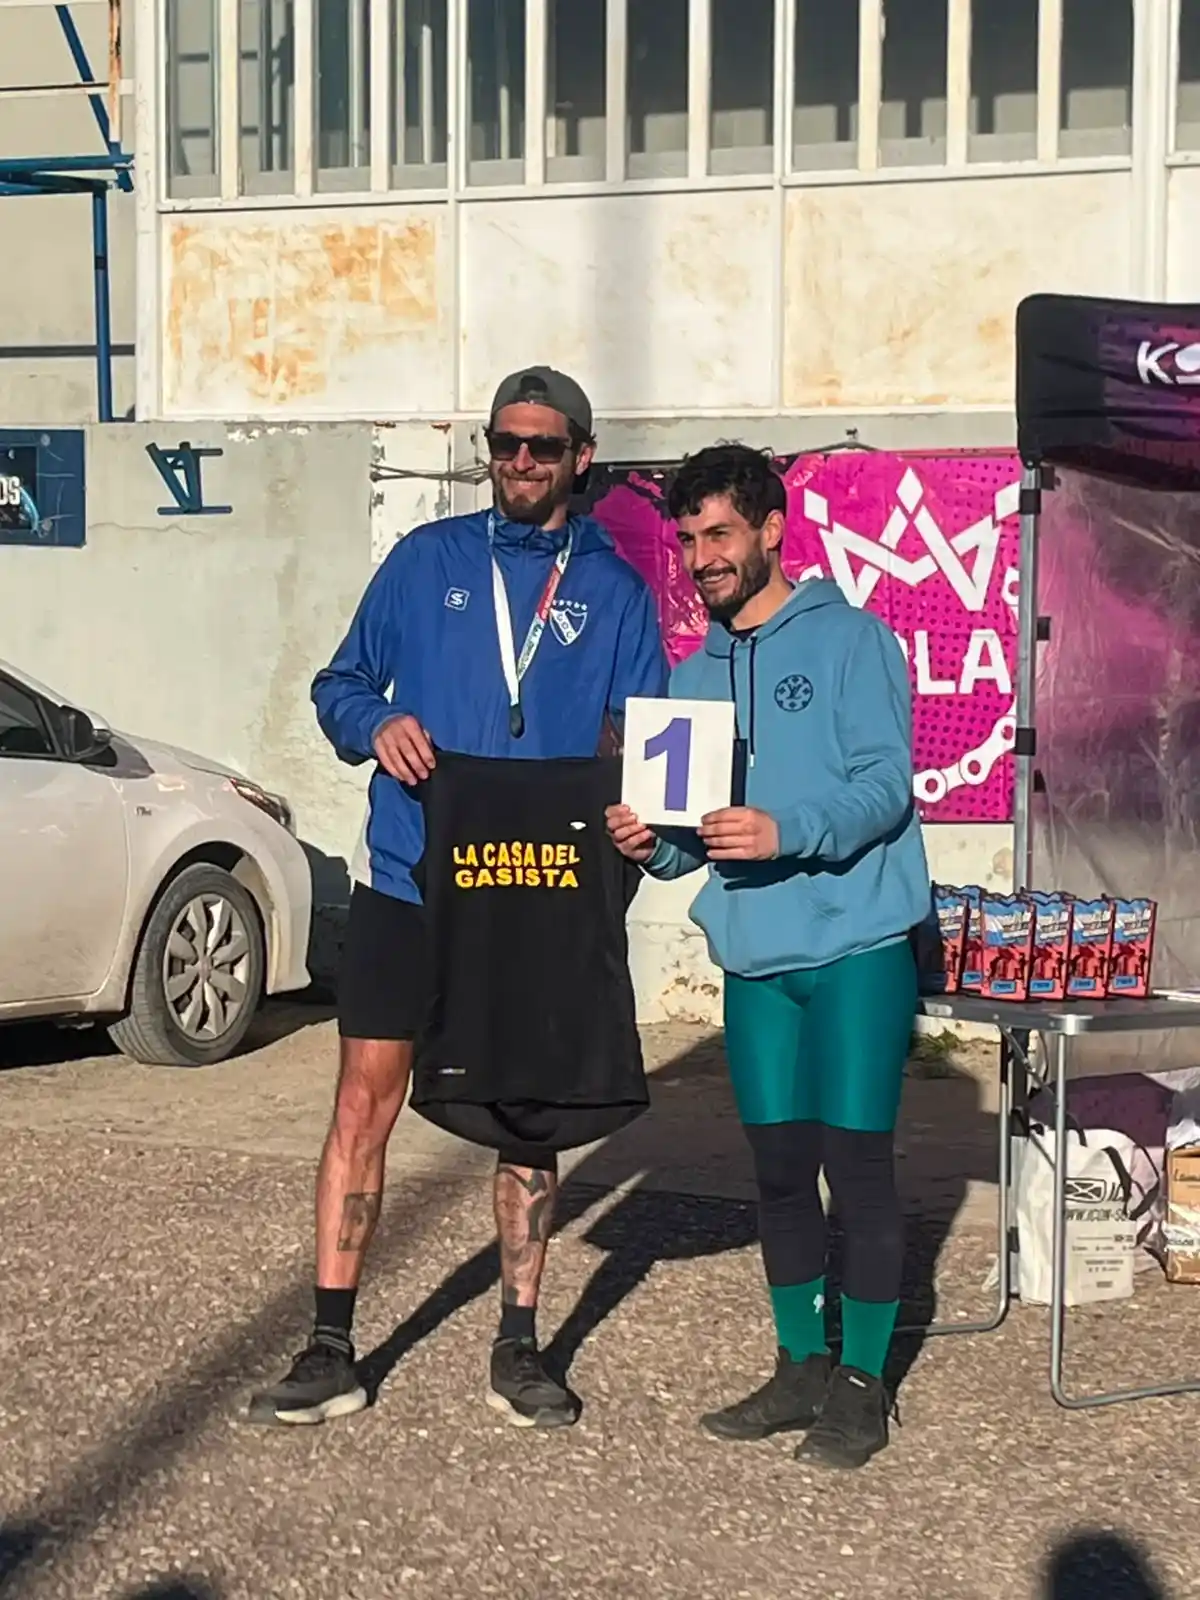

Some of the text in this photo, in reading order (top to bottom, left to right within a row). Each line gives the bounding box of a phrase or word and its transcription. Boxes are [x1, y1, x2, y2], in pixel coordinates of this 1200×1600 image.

[894, 628, 1012, 695] LA
[644, 718, 692, 812] 1
[453, 841, 580, 867] LA CASA DEL
[455, 868, 579, 888] GASISTA
